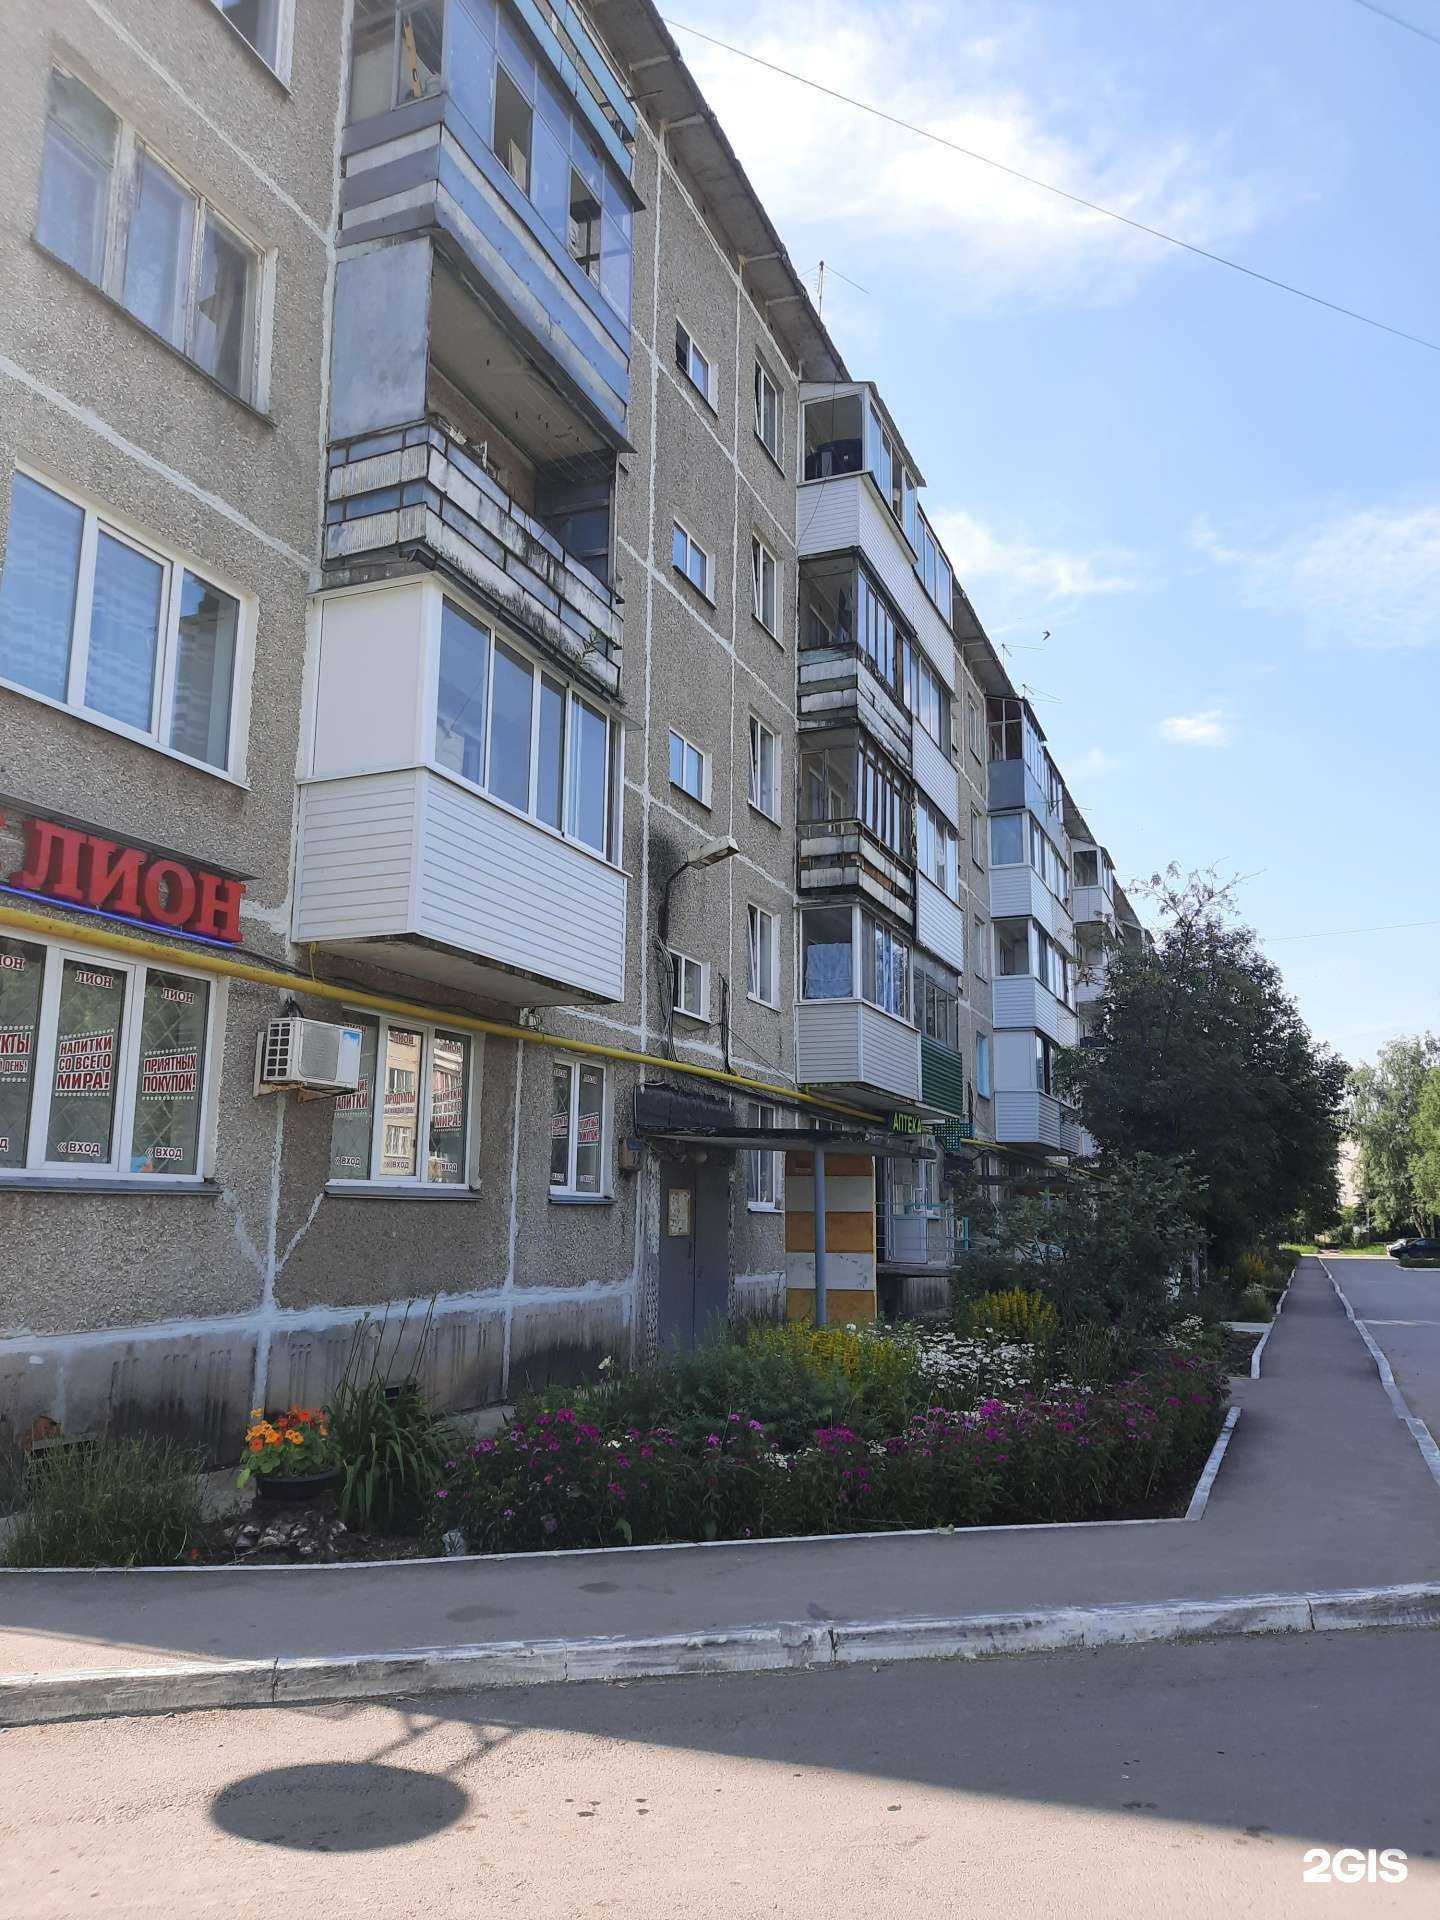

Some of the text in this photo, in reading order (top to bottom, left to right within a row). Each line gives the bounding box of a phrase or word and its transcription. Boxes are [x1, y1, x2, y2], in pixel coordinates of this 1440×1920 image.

[12, 818, 246, 942] ЛИОН
[0, 955, 25, 970] ОН
[76, 970, 113, 988] ЛИОН
[162, 988, 194, 1004] ЛИОН
[59, 1036, 113, 1055] НАПИТКИ
[58, 1053, 112, 1071] СО ВСЕГО
[144, 1053, 198, 1074] ПРИЯТНЫХ
[56, 1071, 111, 1090] МИРА!
[142, 1073, 197, 1093] ПОКУПОК!
[892, 1111, 922, 1134] АПТЕКА
[68, 1142, 100, 1155] ВХОД
[154, 1147, 183, 1160] ВХОД
[341, 1155, 360, 1166] ВХОД
